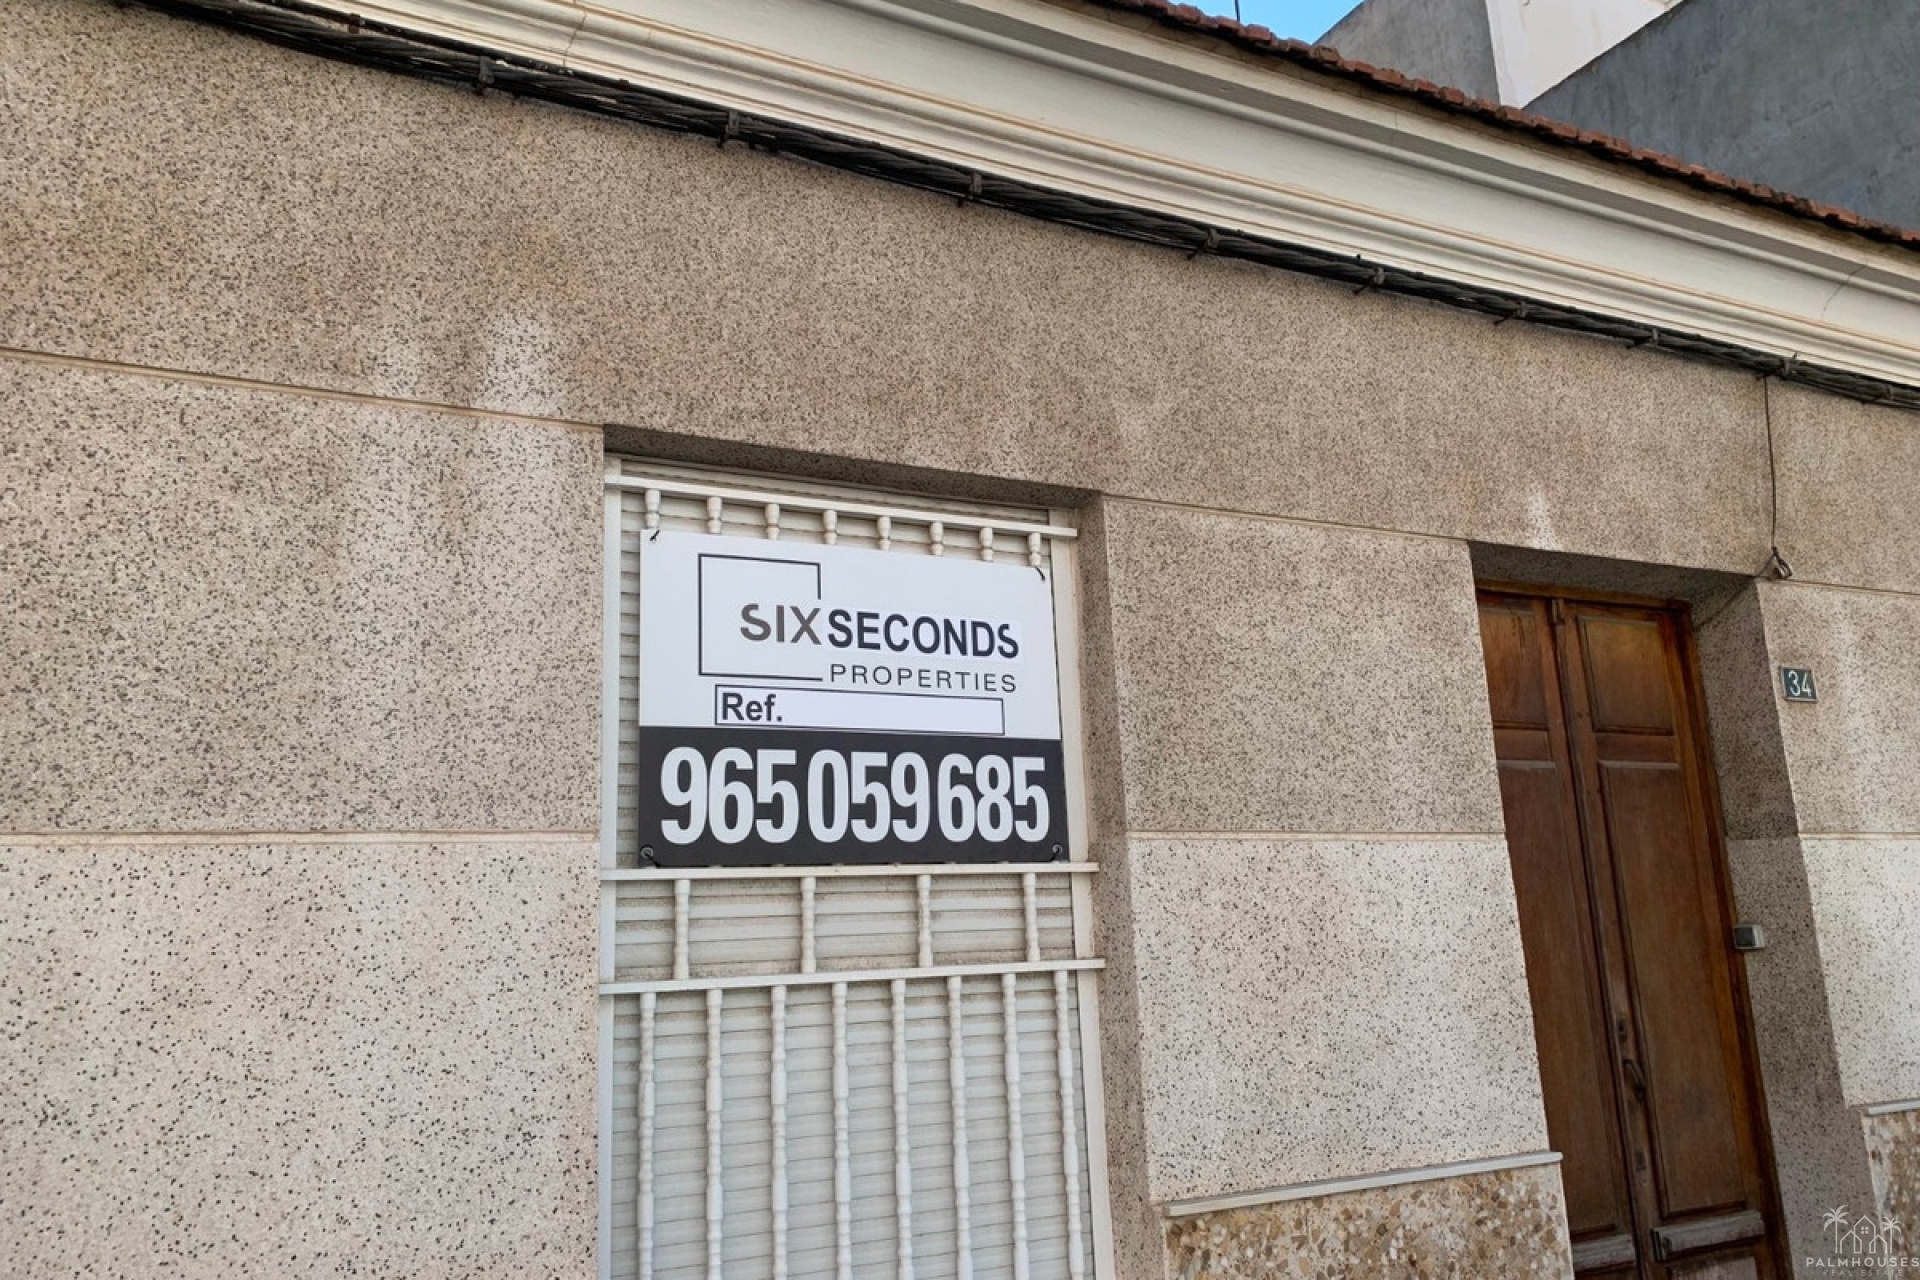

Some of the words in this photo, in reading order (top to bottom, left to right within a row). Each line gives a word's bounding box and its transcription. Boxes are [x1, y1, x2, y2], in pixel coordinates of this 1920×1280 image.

[830, 664, 1017, 692] PROPERTIES
[1788, 670, 1812, 697] 34
[721, 693, 783, 722] Ref.
